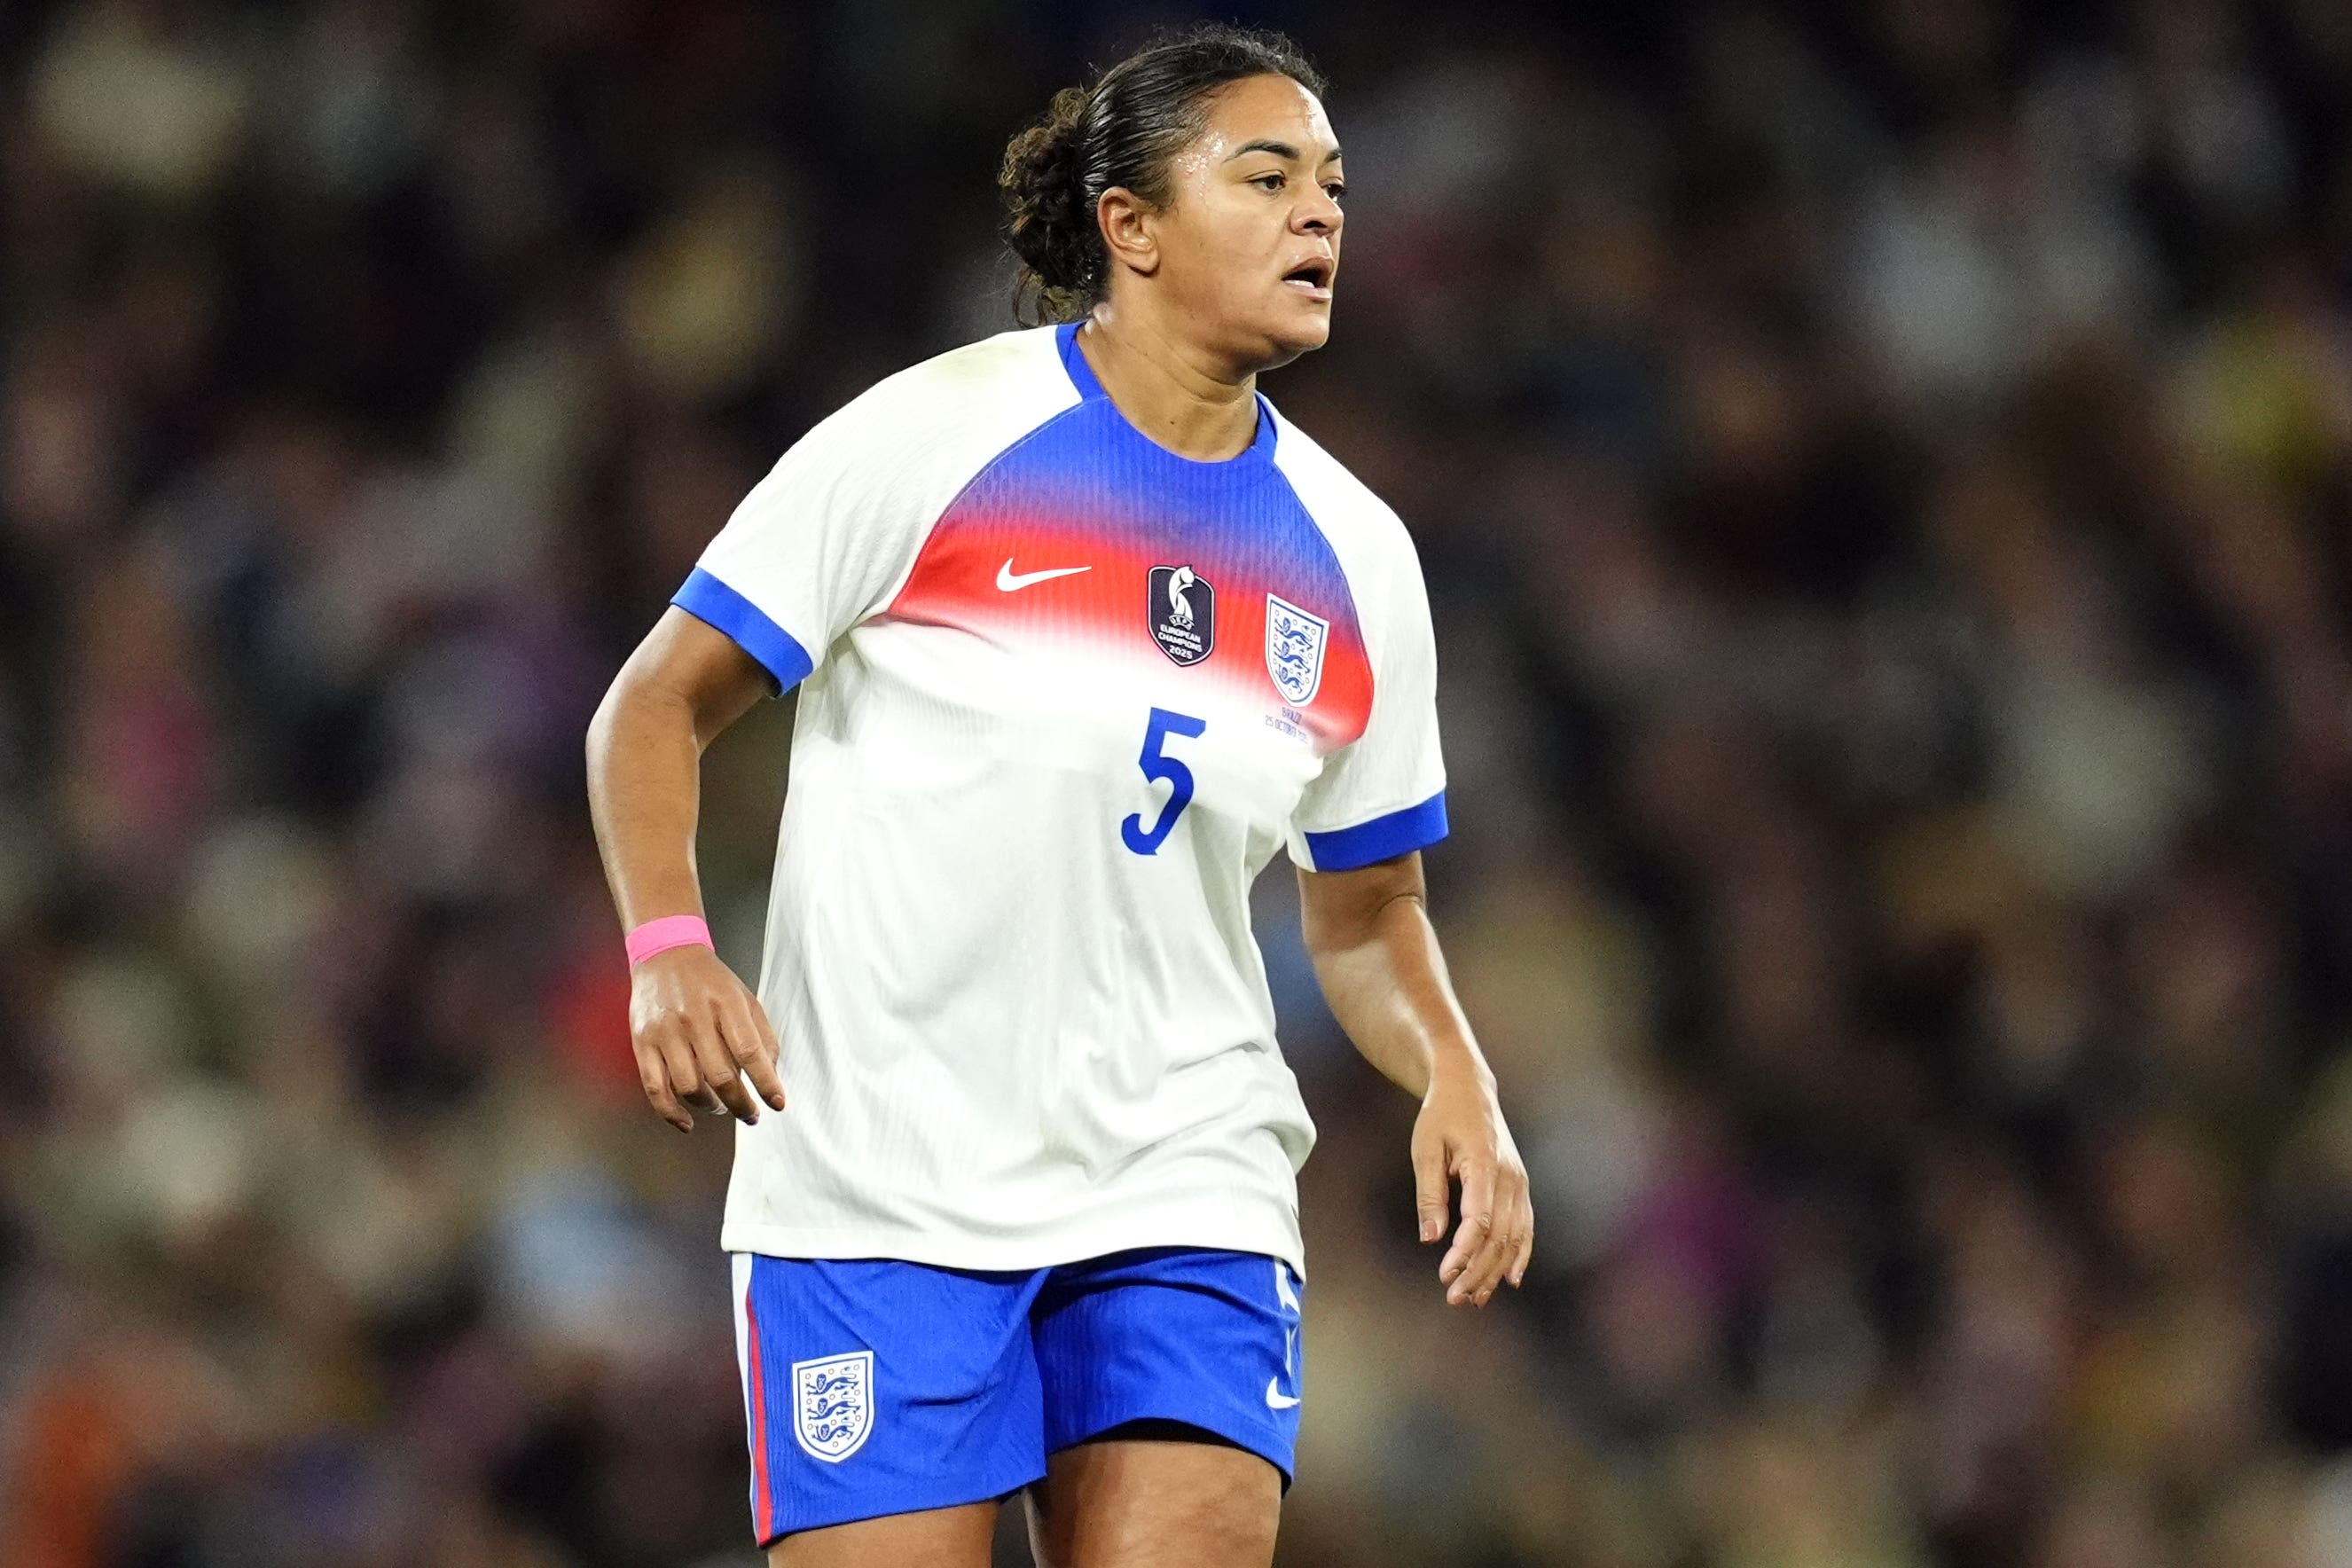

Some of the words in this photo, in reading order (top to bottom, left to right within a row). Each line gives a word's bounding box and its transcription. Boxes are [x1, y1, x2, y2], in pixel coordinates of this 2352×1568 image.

[1157, 632, 1203, 652] CHAMPIONS
[1160, 624, 1201, 643] EUROPEAN
[1169, 645, 1193, 659] 2025
[1121, 707, 1206, 856] 5
